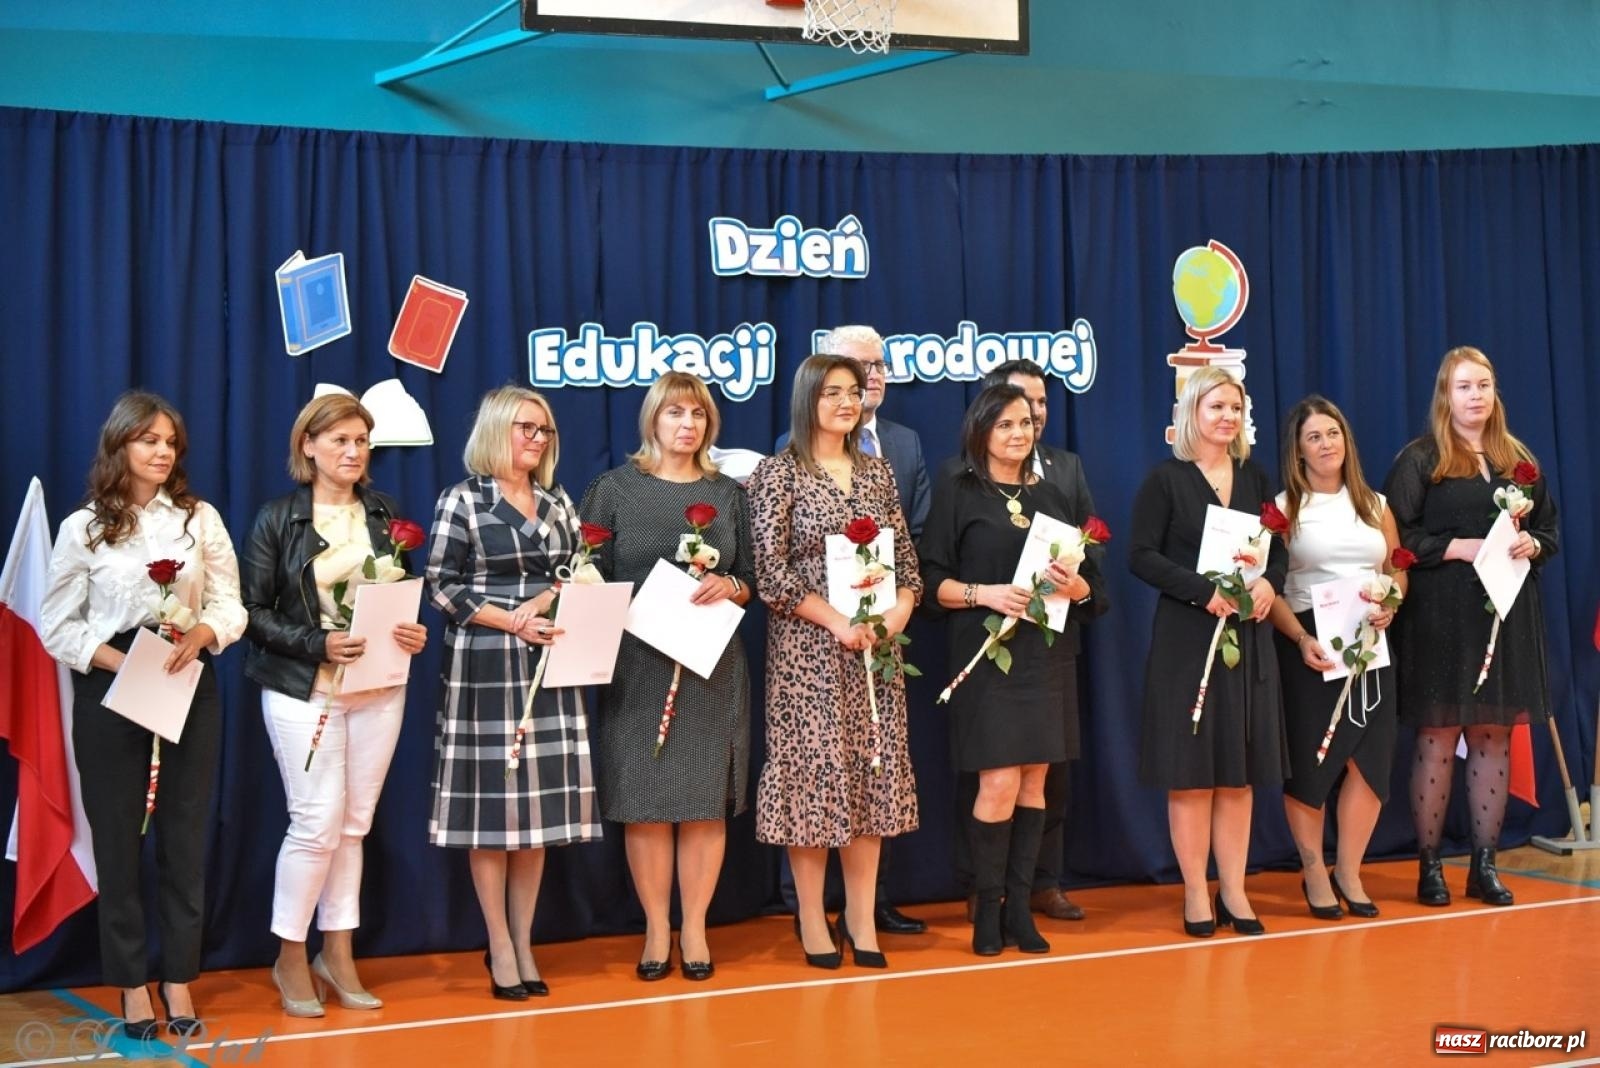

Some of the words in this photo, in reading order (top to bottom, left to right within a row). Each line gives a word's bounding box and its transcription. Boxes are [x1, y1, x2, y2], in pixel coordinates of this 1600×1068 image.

[711, 217, 867, 276] Dzień
[531, 324, 774, 399] Edukacji
[813, 321, 1096, 391] rodowej
